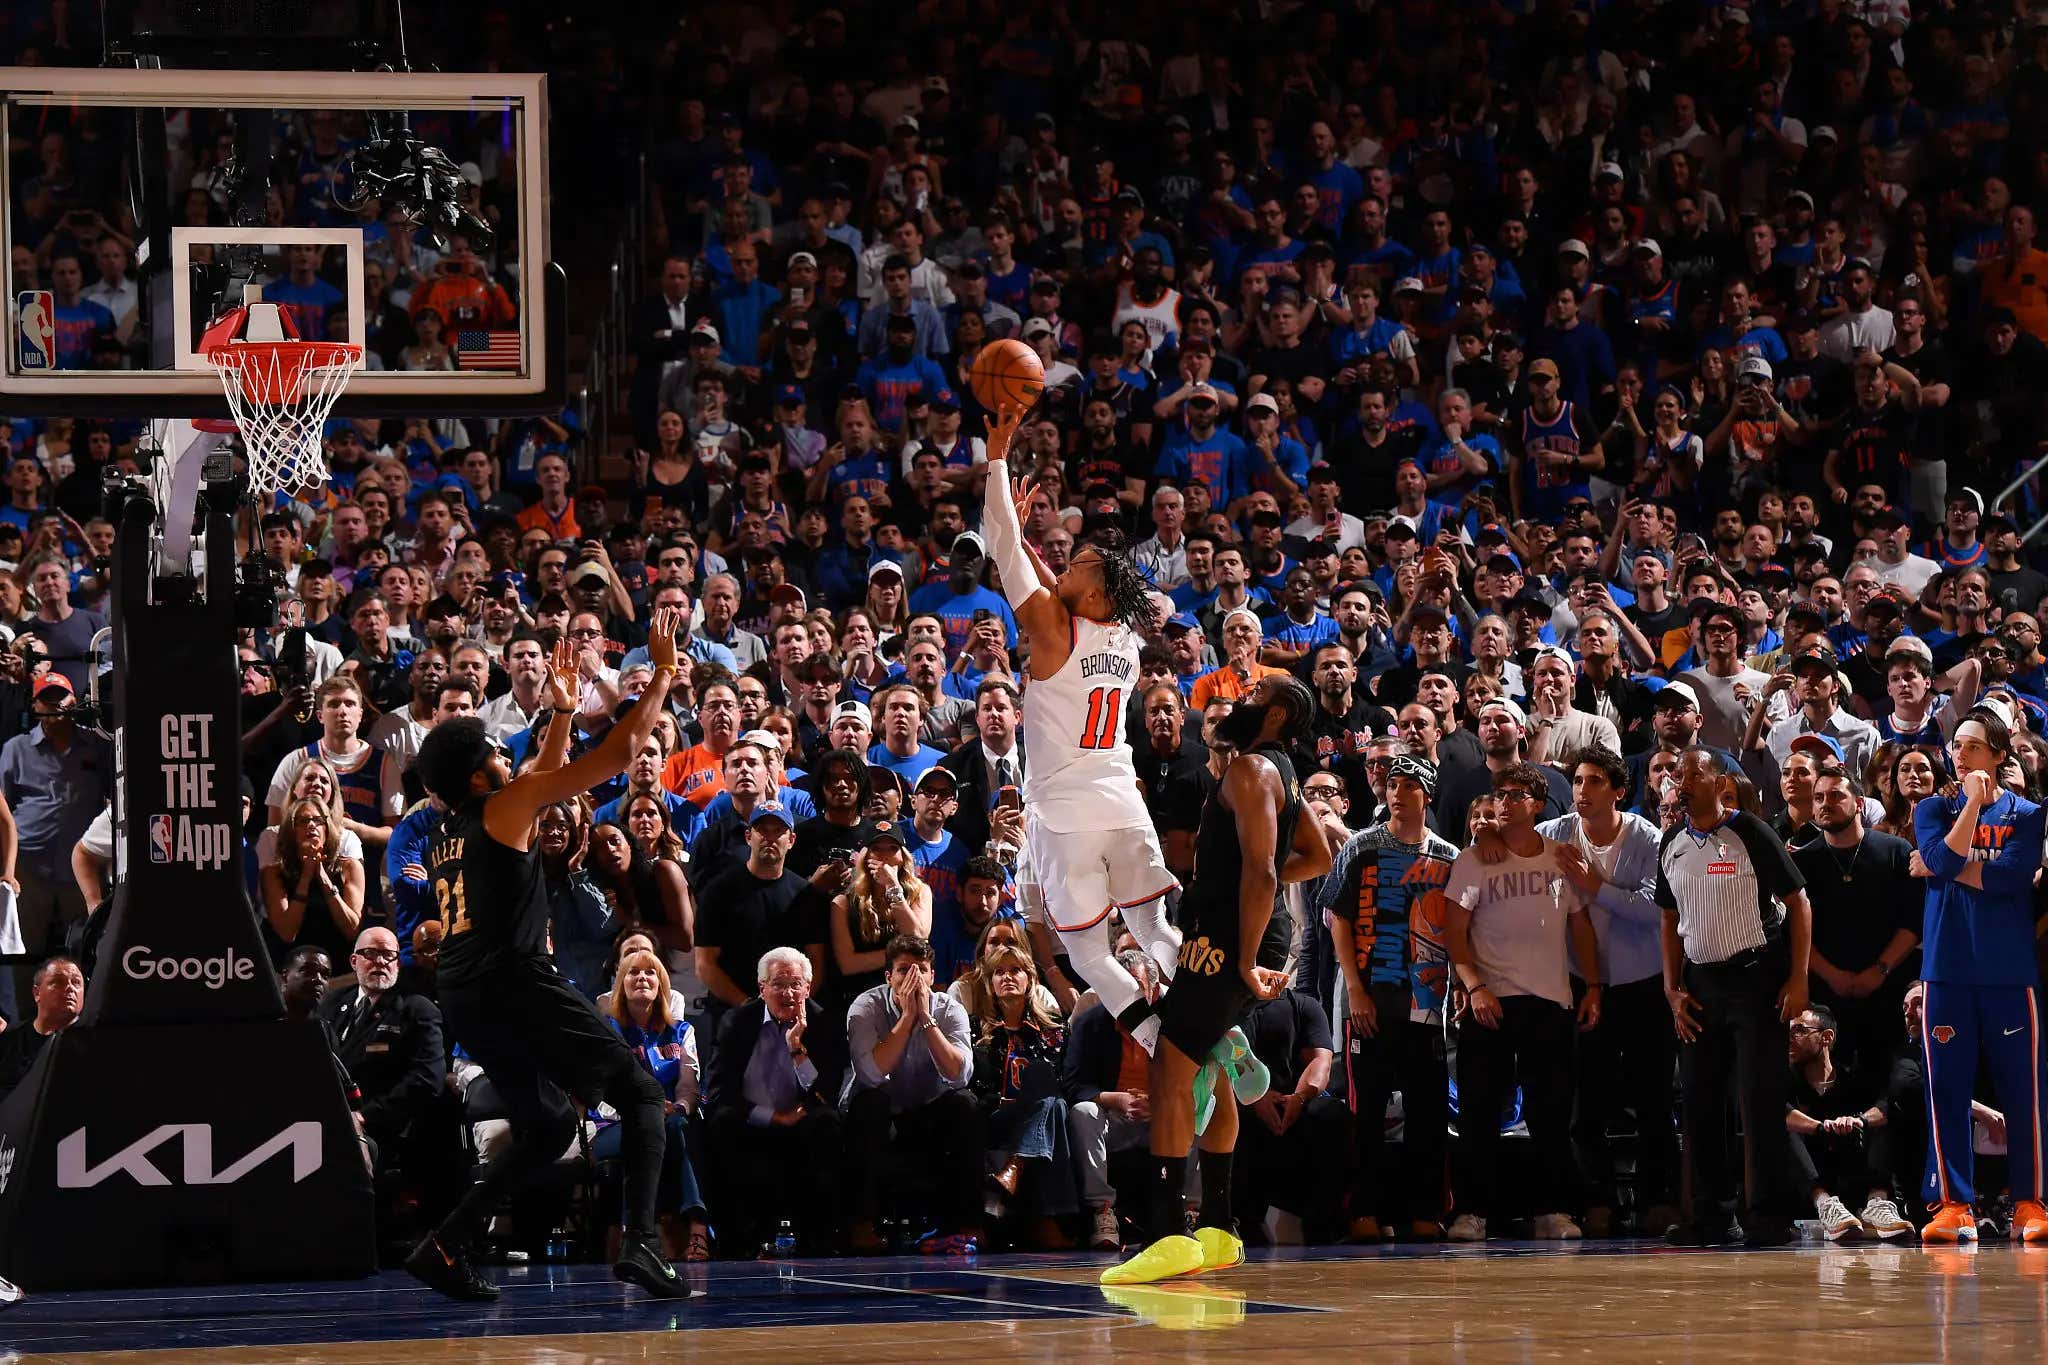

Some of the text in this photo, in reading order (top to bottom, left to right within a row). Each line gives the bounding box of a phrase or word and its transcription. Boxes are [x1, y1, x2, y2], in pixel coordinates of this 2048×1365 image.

[24, 352, 42, 365] NBA
[1080, 653, 1133, 681] BRUNSON
[160, 714, 214, 759] GET
[1080, 687, 1121, 750] 11
[160, 763, 217, 809] THE
[176, 815, 231, 871] App
[1487, 871, 1560, 904] KNICK
[1708, 864, 1735, 873] Emirates
[435, 869, 473, 942] 31
[122, 945, 255, 989] Google
[1176, 936, 1226, 977] AVS
[57, 1121, 323, 1188] KIA
